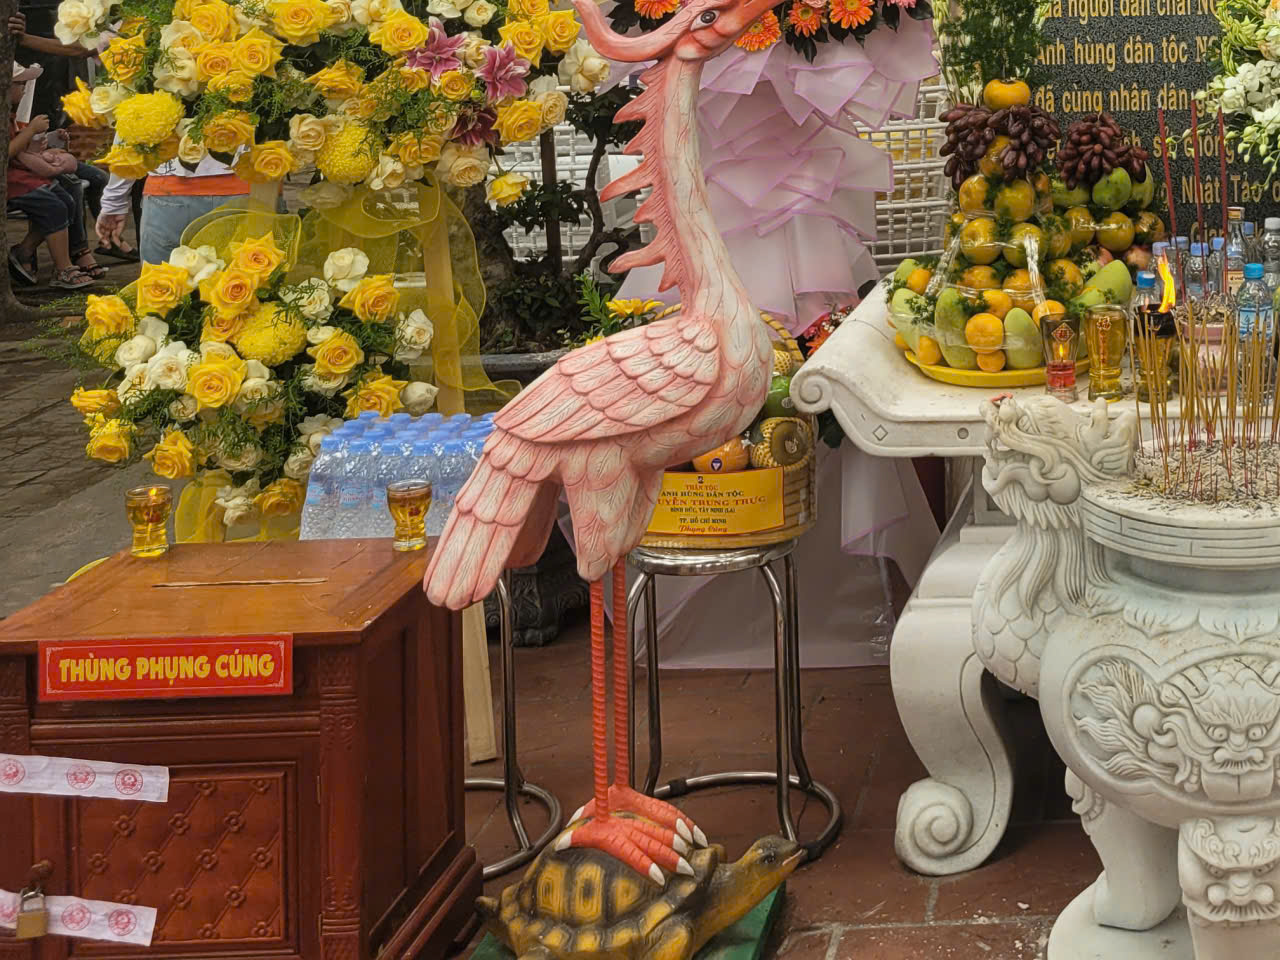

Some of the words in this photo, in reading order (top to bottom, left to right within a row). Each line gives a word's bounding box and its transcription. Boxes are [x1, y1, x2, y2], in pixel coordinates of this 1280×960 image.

[1074, 36, 1116, 72] hùng
[1123, 36, 1154, 64] dân
[1161, 36, 1188, 69] tộc
[1035, 85, 1055, 113] đã
[1062, 83, 1103, 113] cùng
[1109, 83, 1150, 112] nhân
[1158, 83, 1188, 112] dân
[59, 653, 132, 683] THÙNG
[136, 655, 210, 685] PHỤNG
[215, 649, 275, 678] CÚNG
